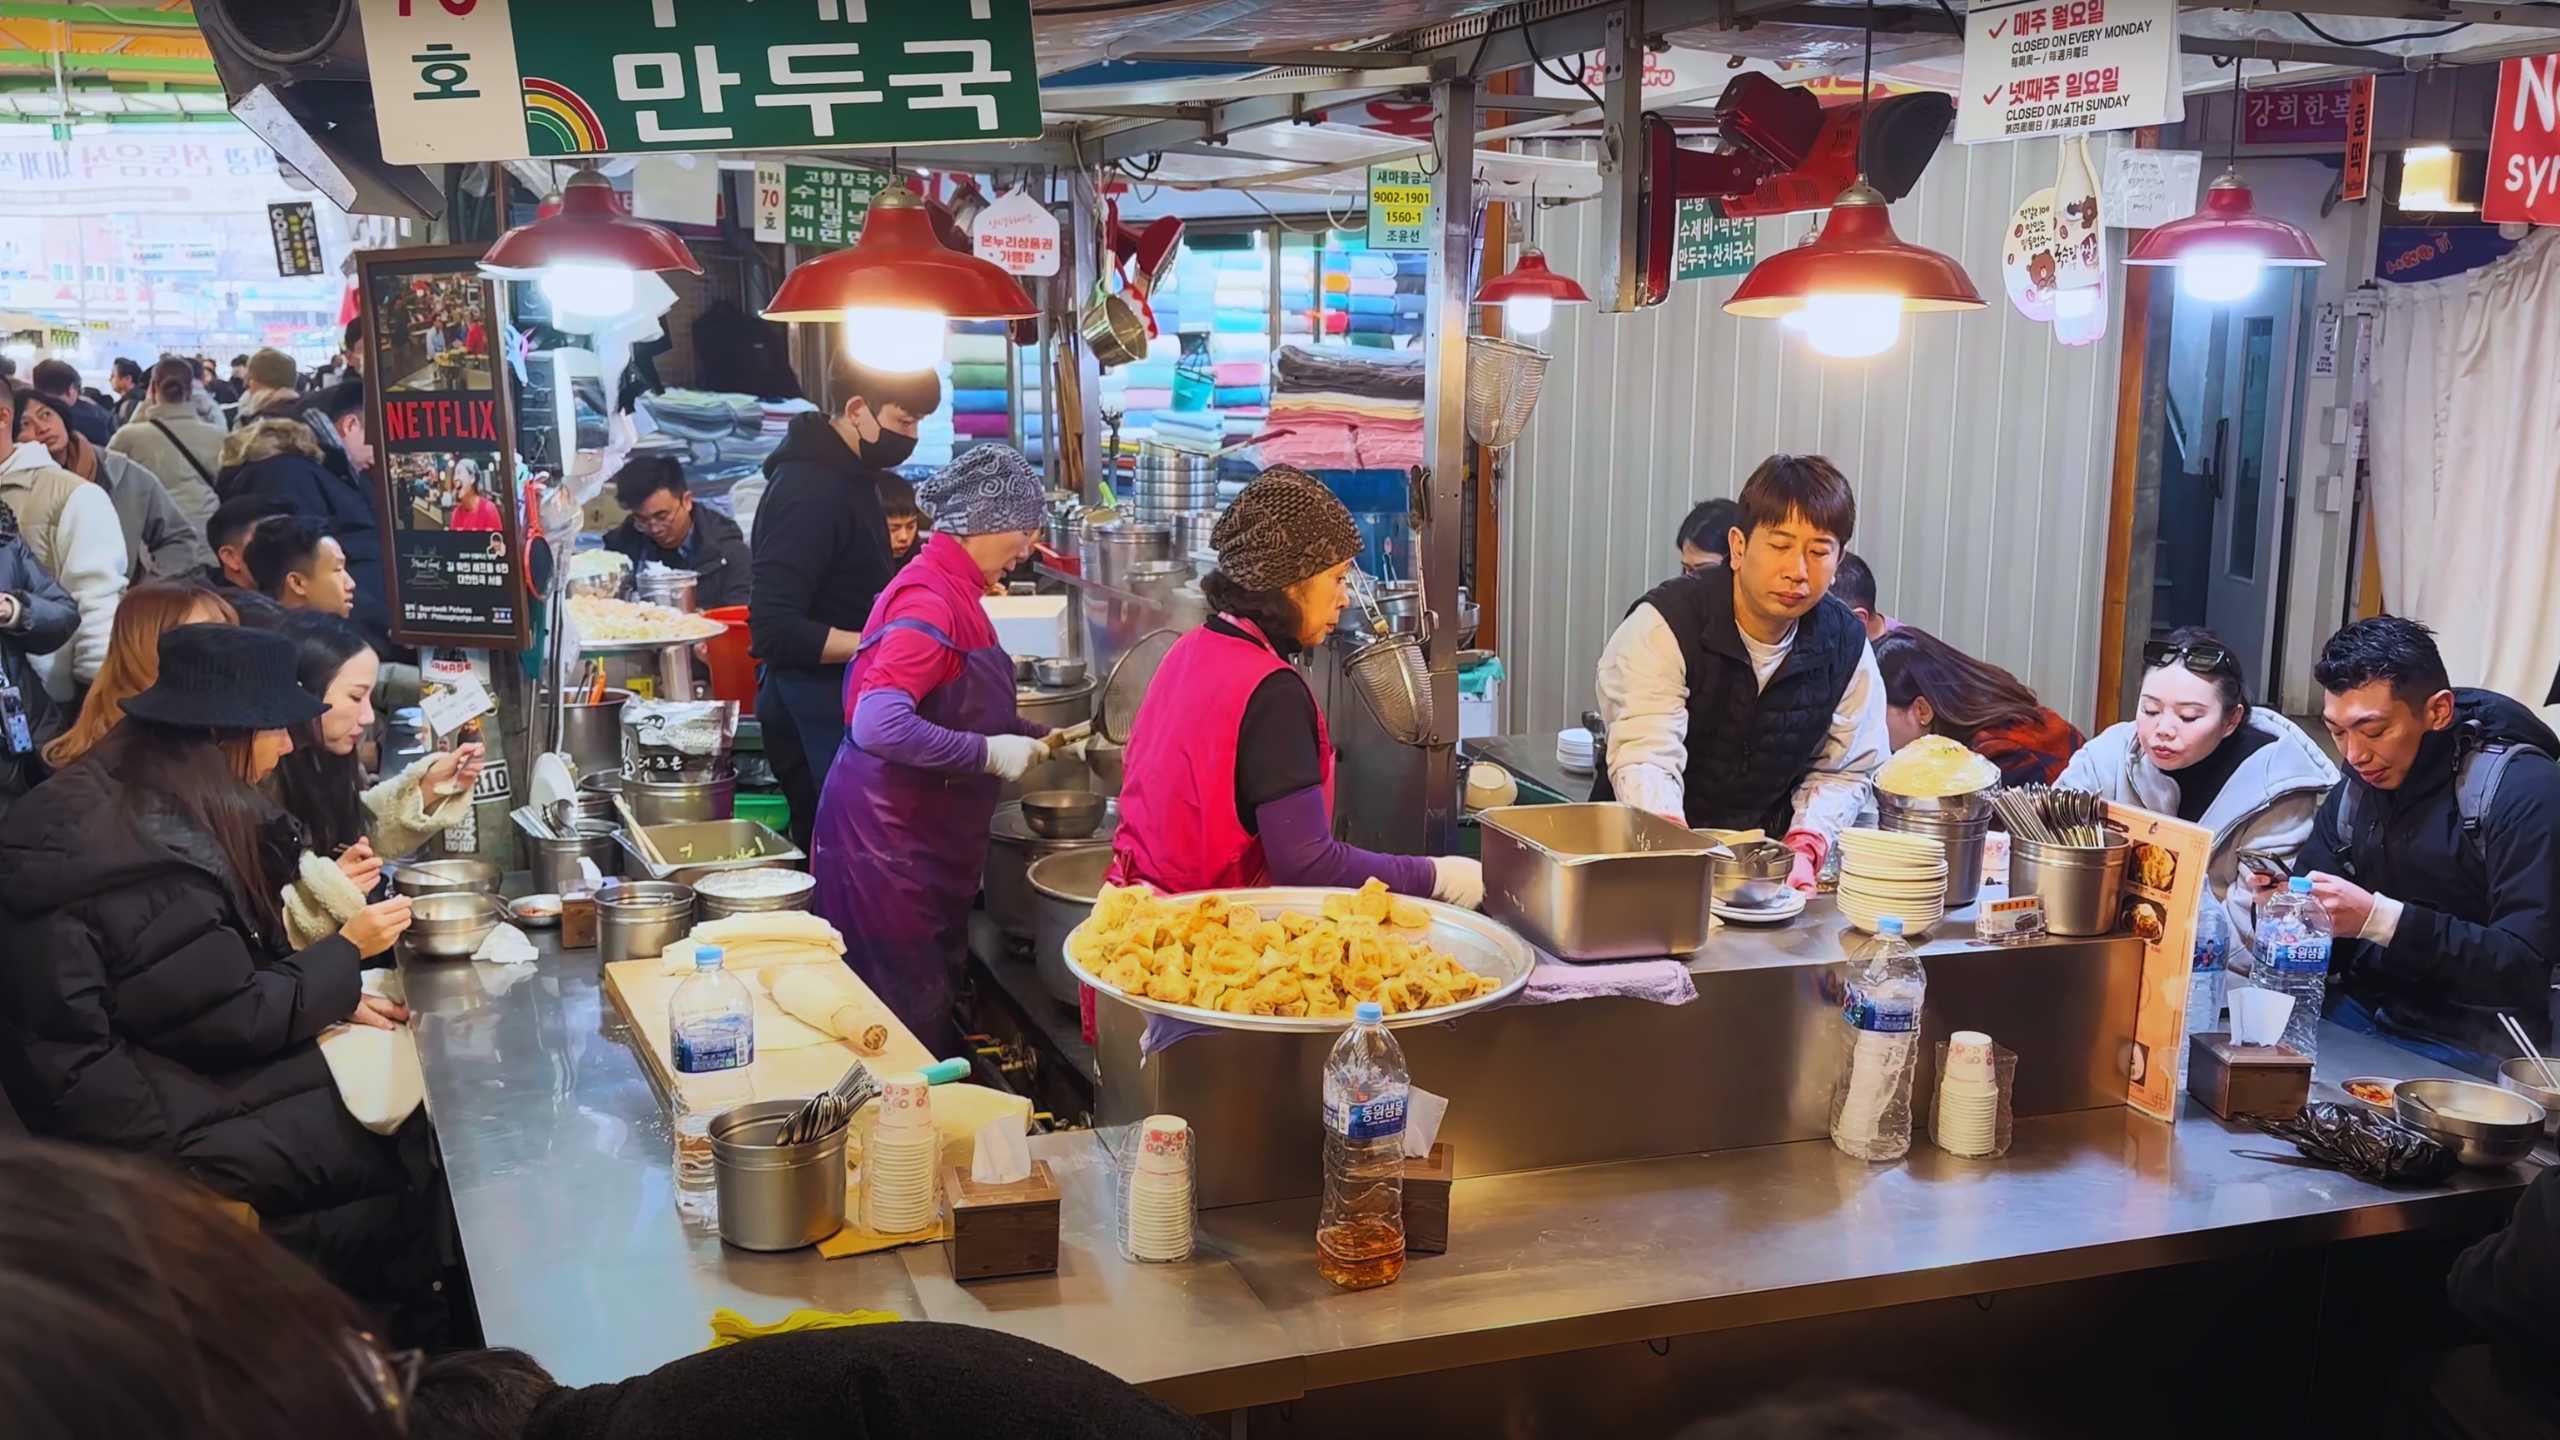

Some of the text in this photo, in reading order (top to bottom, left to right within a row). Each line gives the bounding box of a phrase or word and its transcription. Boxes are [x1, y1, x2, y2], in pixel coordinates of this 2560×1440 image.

[2013, 0, 2104, 36] 매주 월요일
[2011, 19, 2153, 54] CLOSED ON EVERY MONDAY
[412, 44, 480, 100] 호
[612, 39, 1012, 142] 만두국
[2008, 67, 2120, 106] 넷째주 일요일
[2513, 53, 2560, 132] N
[2006, 94, 2131, 122] CLOSED ON 4TH SUNDAY
[804, 170, 908, 188] 고향 칼국수
[762, 190, 779, 206] 70
[1374, 191, 1430, 204] 9002-1901
[764, 212, 777, 230] 호
[1386, 211, 1421, 223] 1560-1
[1386, 229, 1421, 243] 조윤선
[386, 400, 497, 441] NETFLIX
[1361, 1100, 1404, 1123] 동원샘물
